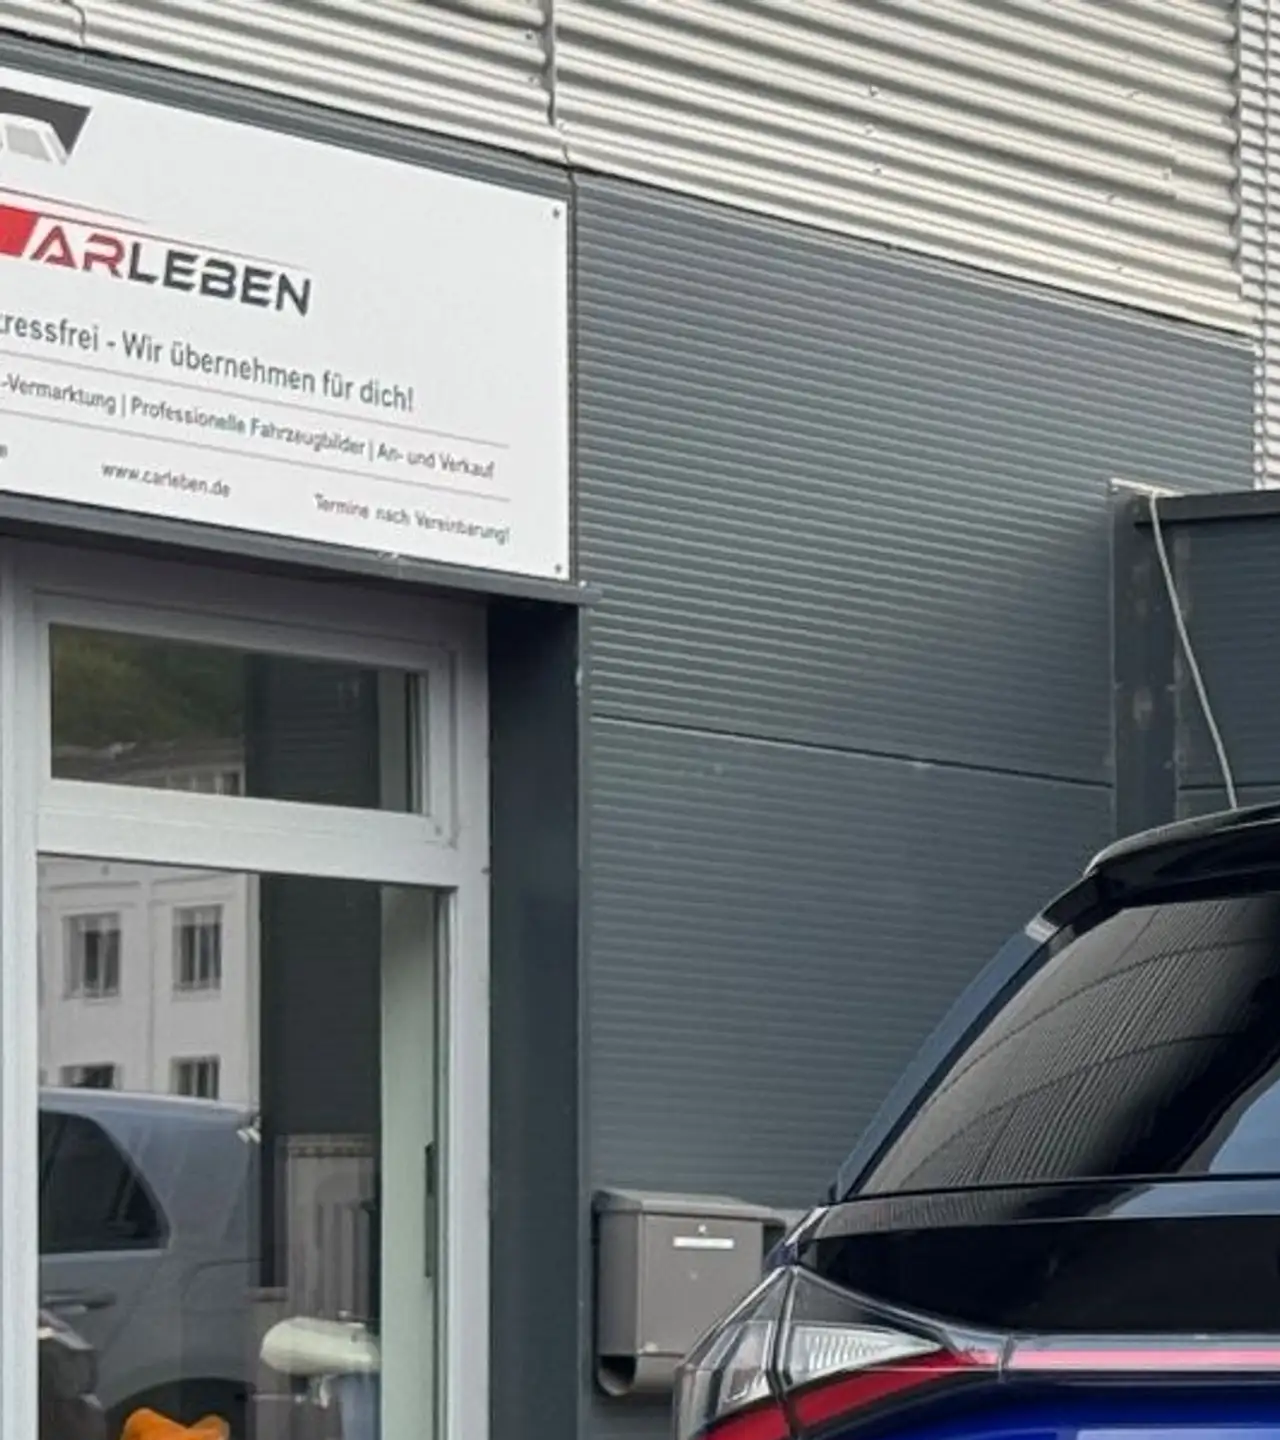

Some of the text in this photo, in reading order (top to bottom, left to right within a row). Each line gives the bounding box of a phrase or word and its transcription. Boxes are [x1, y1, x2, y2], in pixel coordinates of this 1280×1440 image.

[122, 330, 163, 363] Wir
[170, 341, 315, 393] übernehmen
[322, 369, 354, 400] für
[360, 379, 414, 412] dich!
[131, 396, 246, 434] Professionelle
[250, 418, 366, 455] Fahrzeugbilder
[376, 442, 403, 461] An-
[407, 452, 436, 469] und
[439, 453, 495, 479] Verkauf
[101, 462, 231, 498] www.carleben.de
[314, 492, 511, 545] Termine nach Vereinbarung!
